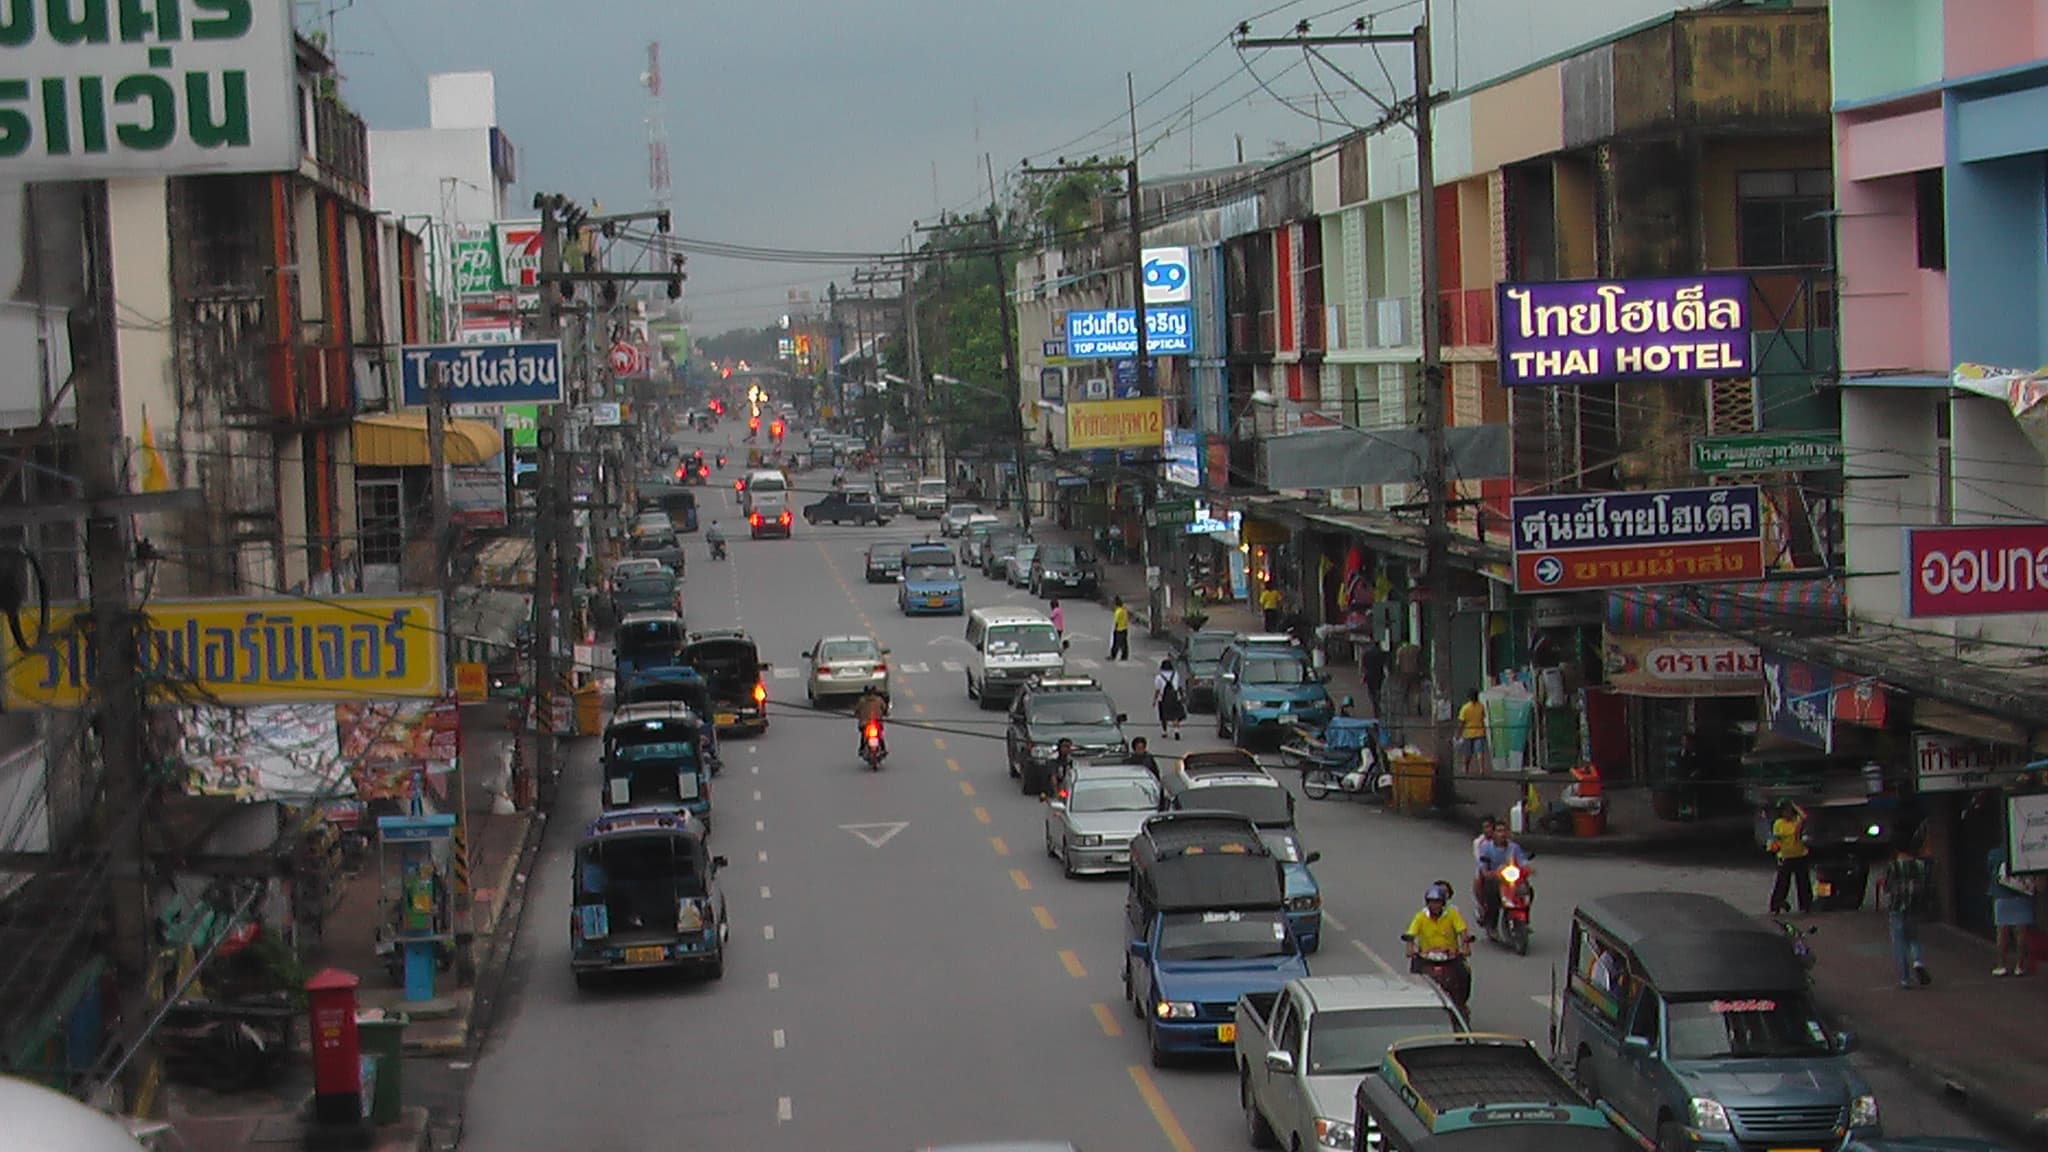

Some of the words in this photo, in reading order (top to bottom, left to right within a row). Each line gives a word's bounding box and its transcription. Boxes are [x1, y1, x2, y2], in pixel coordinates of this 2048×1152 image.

[1507, 284, 1742, 338] ไทยโฮเต็ล
[1074, 342, 1095, 354] TOP
[1146, 338, 1187, 350] OPTICAL
[1510, 348, 1599, 378] THAI
[1616, 343, 1743, 374] HOTEL
[1521, 490, 1752, 549] ศูนย์ไทยโฮเต็ล
[1574, 547, 1744, 581] ขายผ้าส่ง
